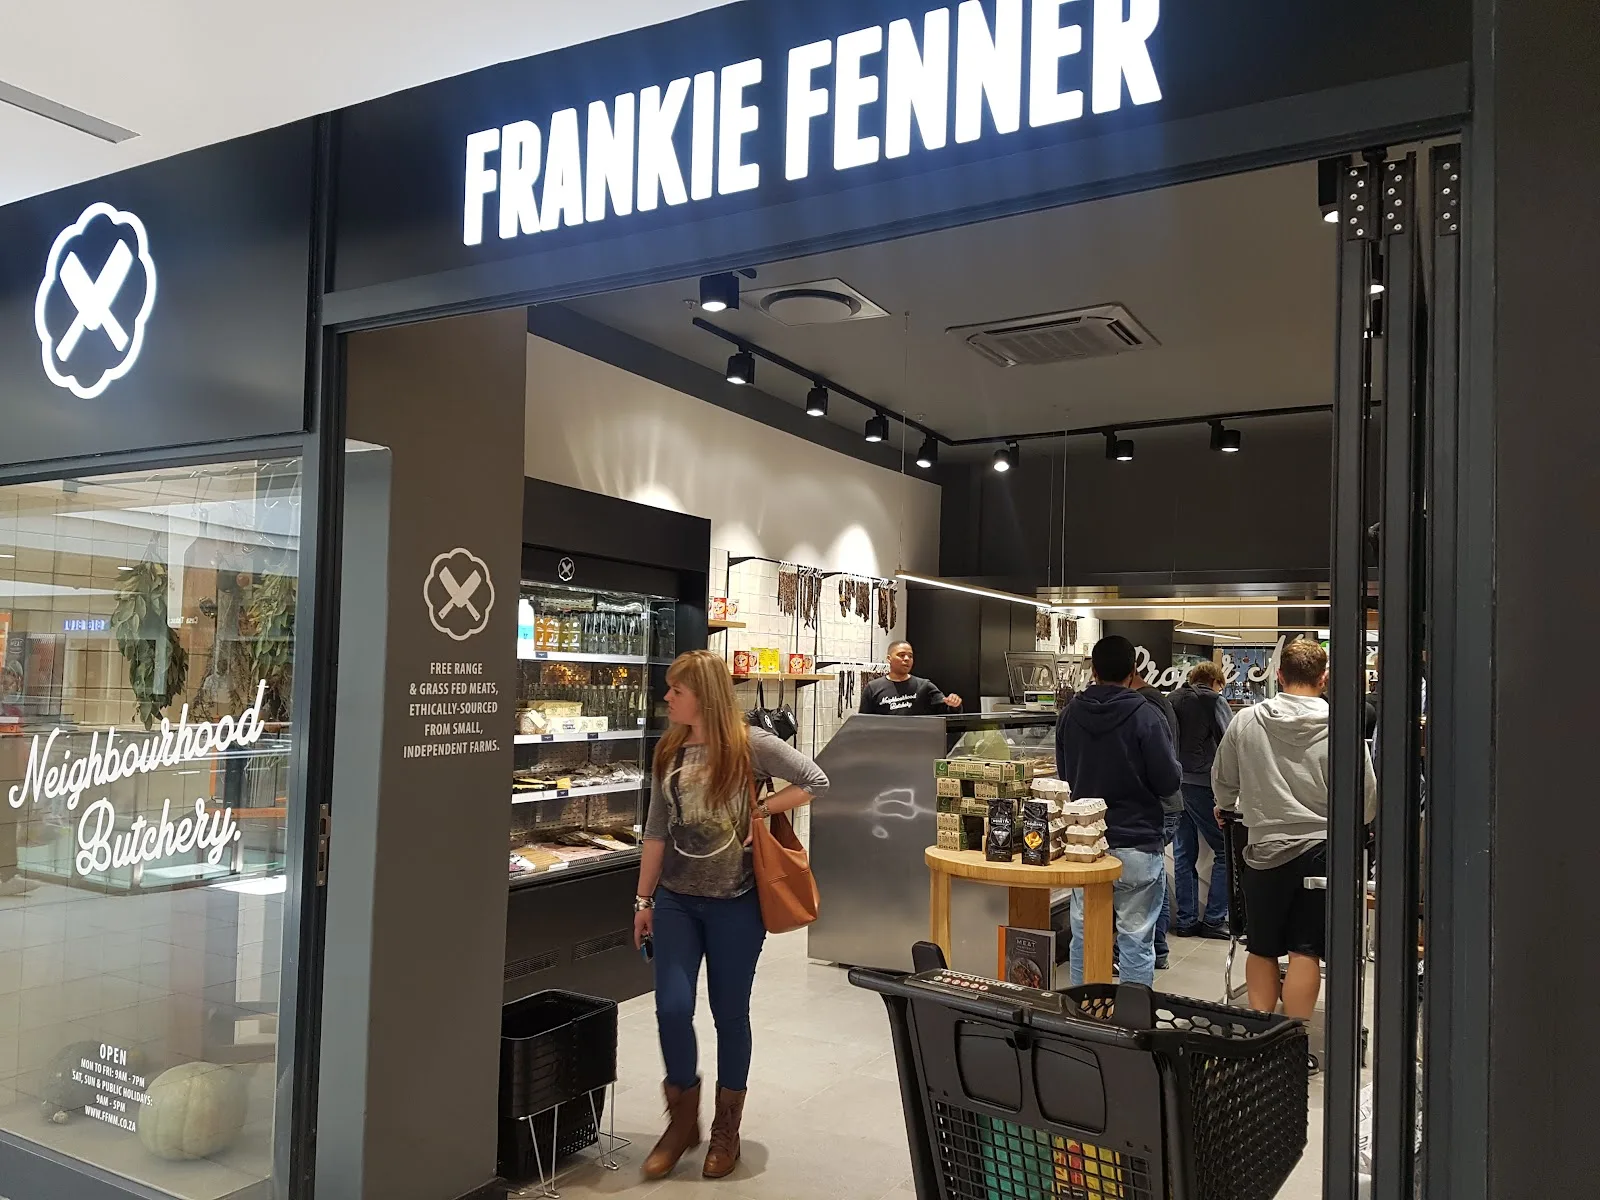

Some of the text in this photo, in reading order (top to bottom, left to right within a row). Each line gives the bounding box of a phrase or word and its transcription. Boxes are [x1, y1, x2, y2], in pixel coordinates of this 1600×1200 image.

[463, 0, 1163, 247] FRANKIE FENNER
[430, 662, 483, 675] FREE RANGE
[1134, 646, 1240, 692] Propr
[409, 682, 499, 695] & GRASS FED MEATS,
[409, 701, 498, 716] ETHICALLY-SOURCED
[424, 721, 484, 736] FROM SMALL,
[8, 679, 265, 811] Neighbourhood
[403, 740, 500, 758] INDEPENDENT FARMS.
[76, 797, 241, 876] Butchery.
[1016, 940, 1036, 948] MEAT
[99, 1043, 127, 1066] OPEN
[80, 1058, 94, 1072] MON
[94, 1062, 101, 1074] TO
[102, 1065, 114, 1077] FRI:
[115, 1070, 128, 1082] 9AM
[132, 1075, 145, 1088] 7PM
[72, 1070, 153, 1106] SAT, SUN & PUBLIC HOLIDAYS:
[96, 1094, 109, 1107] 9AM
[113, 1099, 126, 1113] 5PM
